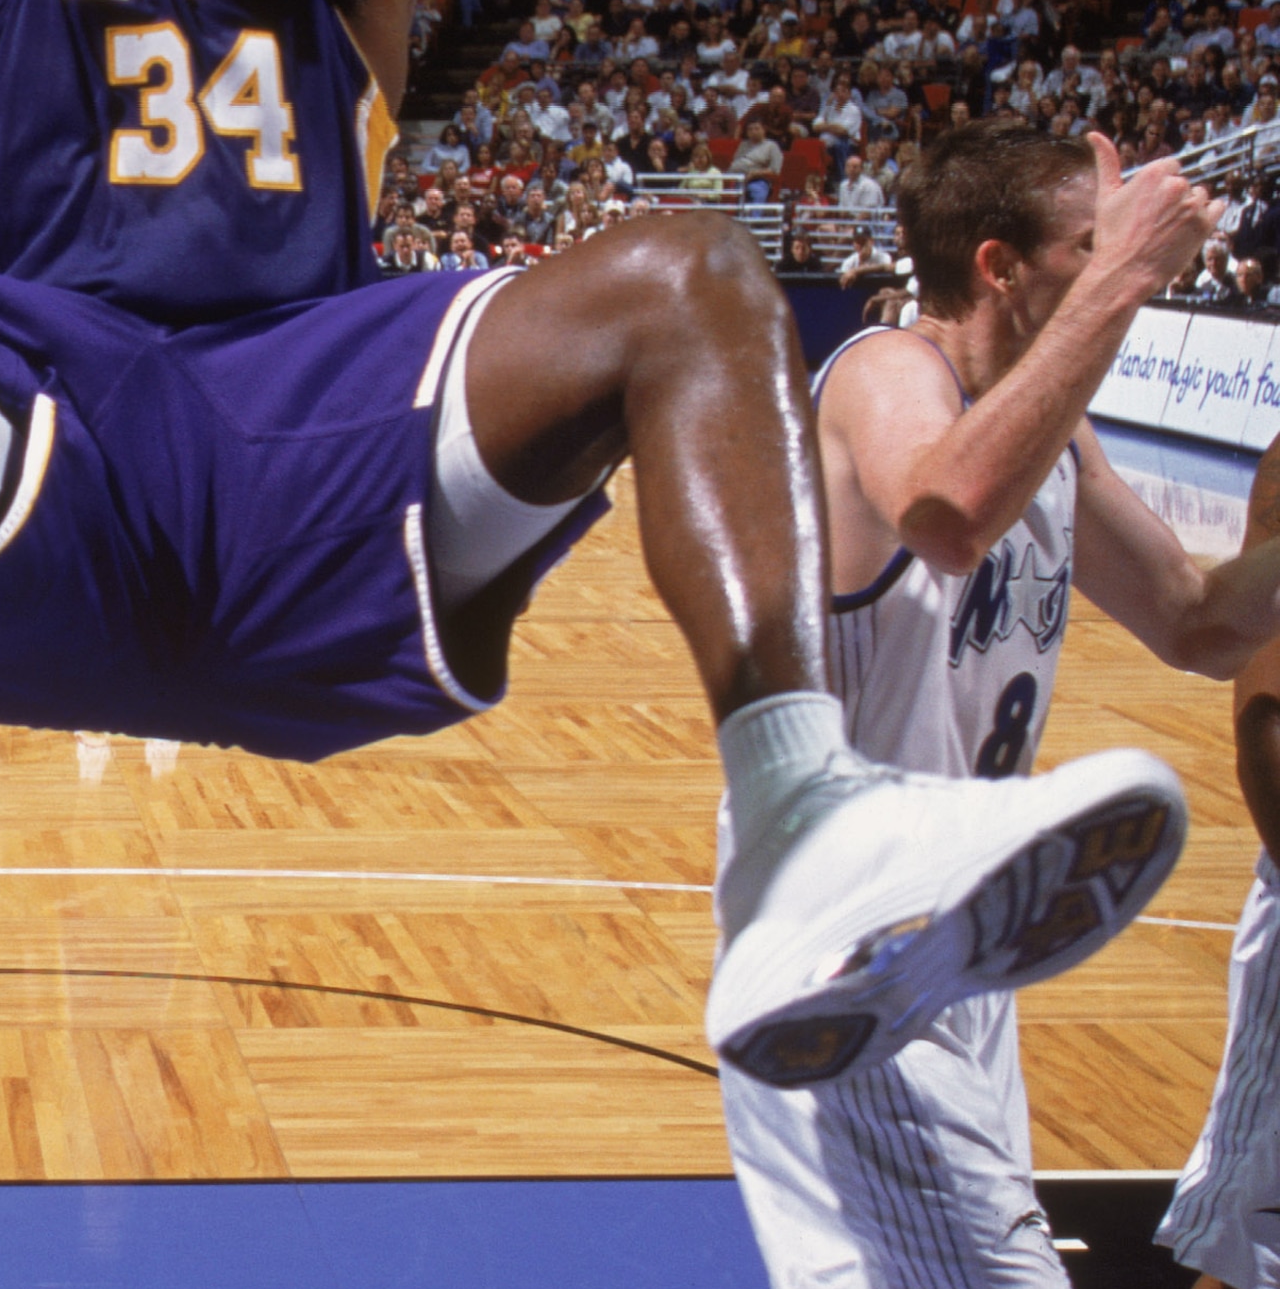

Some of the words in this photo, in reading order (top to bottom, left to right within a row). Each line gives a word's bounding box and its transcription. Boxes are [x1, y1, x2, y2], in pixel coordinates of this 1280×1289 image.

[105, 21, 303, 192] 34
[1158, 358, 1203, 404] magic
[1198, 359, 1252, 411] youth
[974, 671, 1038, 779] 8
